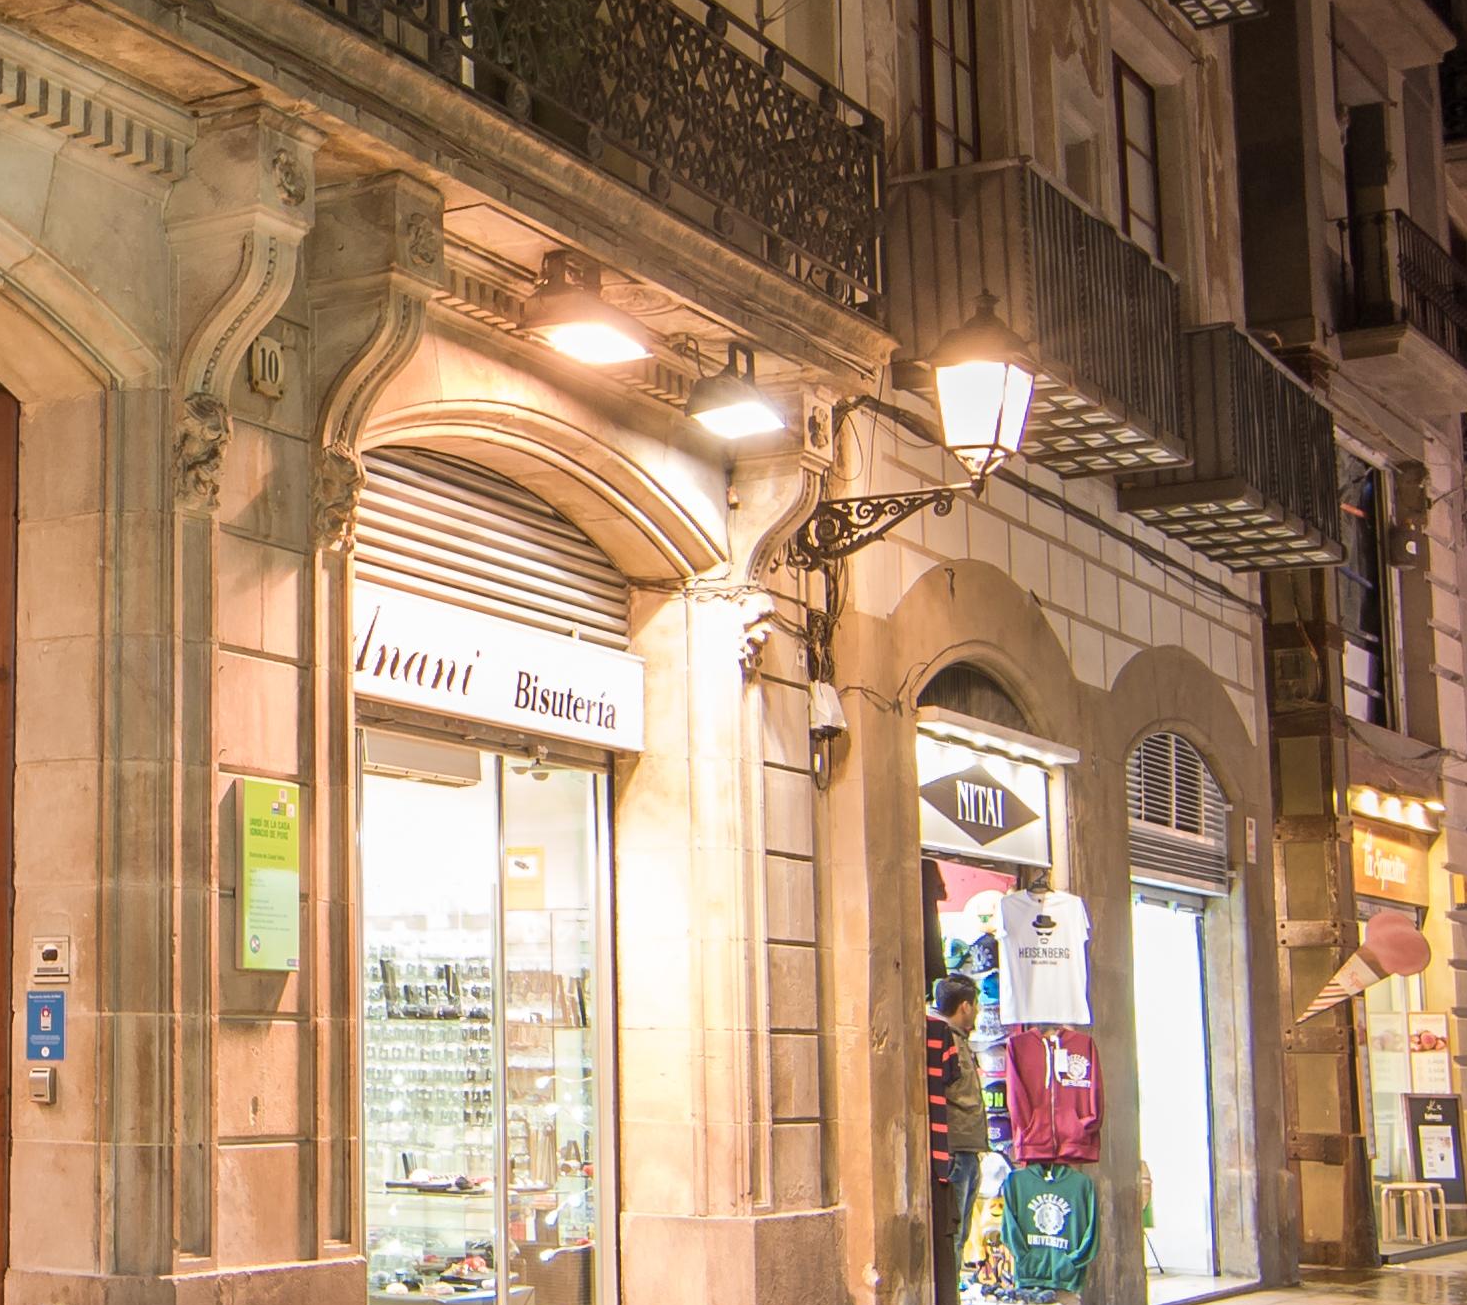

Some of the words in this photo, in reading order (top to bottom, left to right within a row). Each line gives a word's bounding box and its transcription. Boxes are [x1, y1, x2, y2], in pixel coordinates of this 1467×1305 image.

[514, 670, 617, 731] Bisutería
[956, 780, 1004, 828] NITAI
[1018, 947, 1070, 959] HEISENBERG
